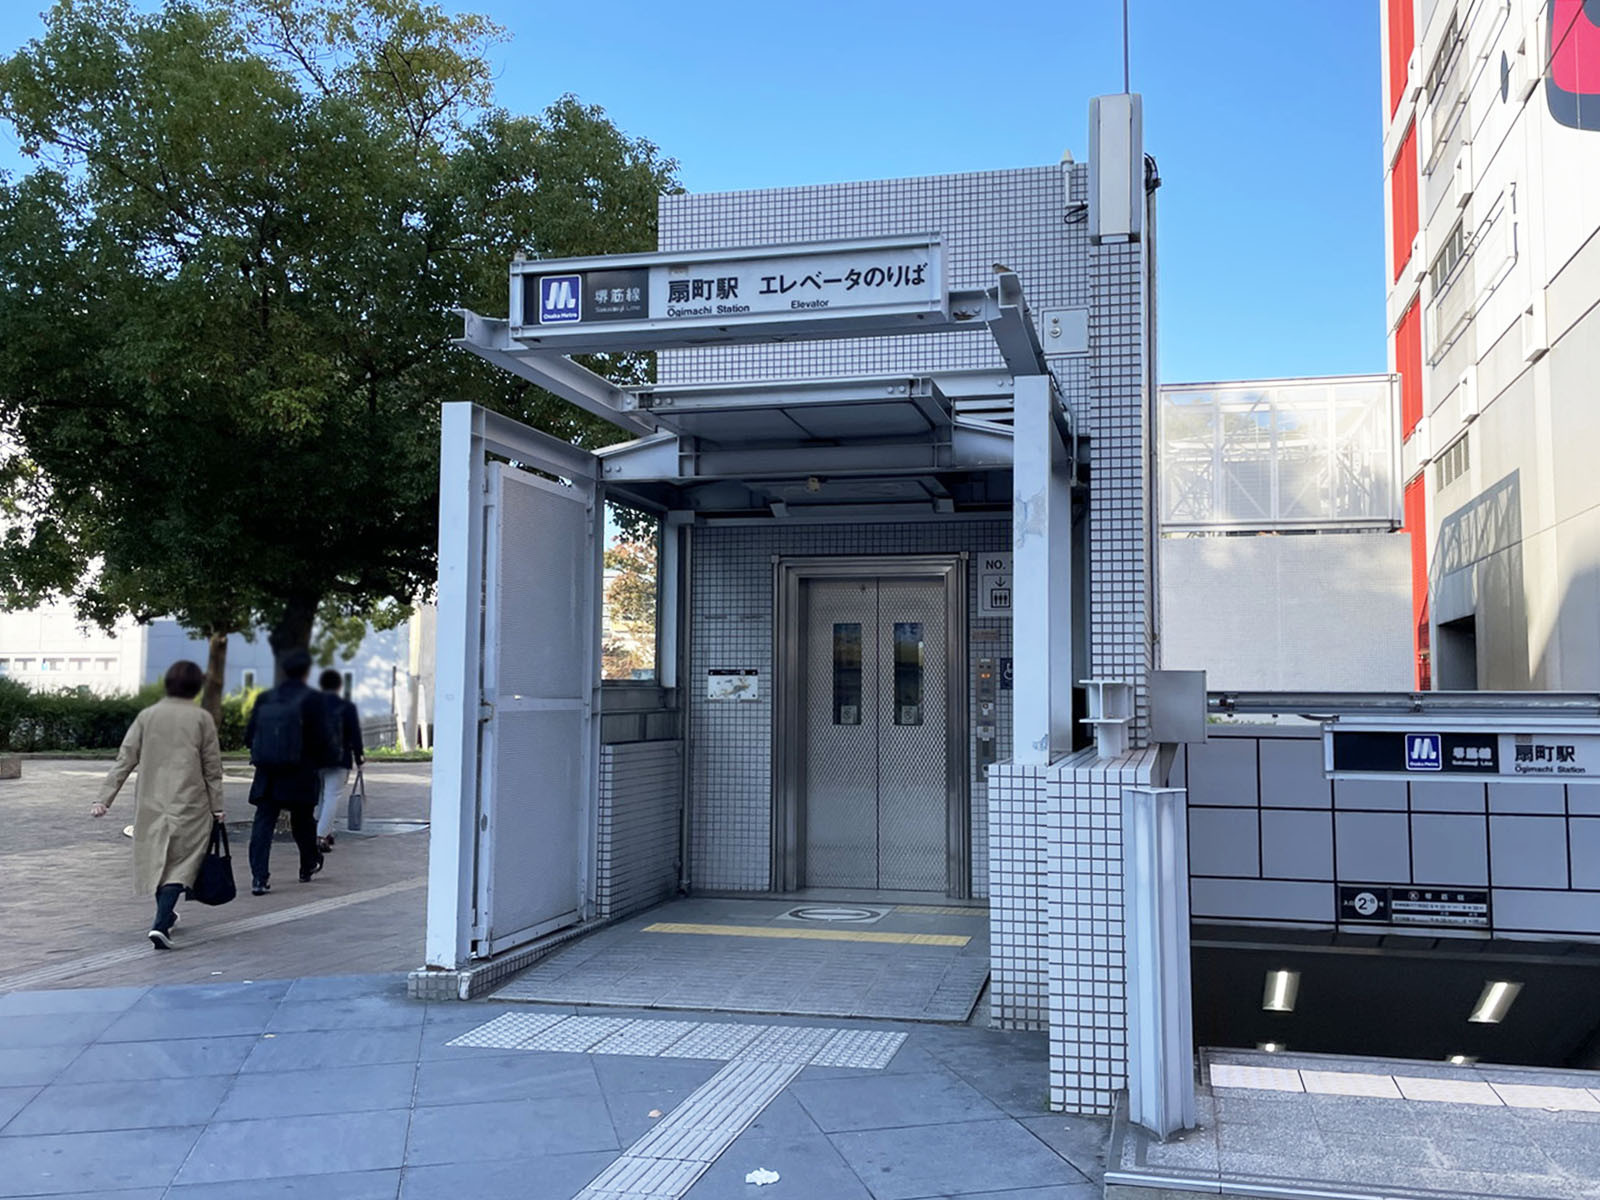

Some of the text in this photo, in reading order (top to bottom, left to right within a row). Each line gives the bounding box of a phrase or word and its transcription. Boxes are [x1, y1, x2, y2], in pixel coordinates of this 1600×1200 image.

[759, 262, 928, 295] エレベータのりば
[667, 277, 739, 303] 扇町駅
[717, 304, 750, 314] Station
[791, 299, 829, 309] Elevator
[986, 560, 1006, 570] NO.
[1515, 745, 1575, 762] 扇町駅
